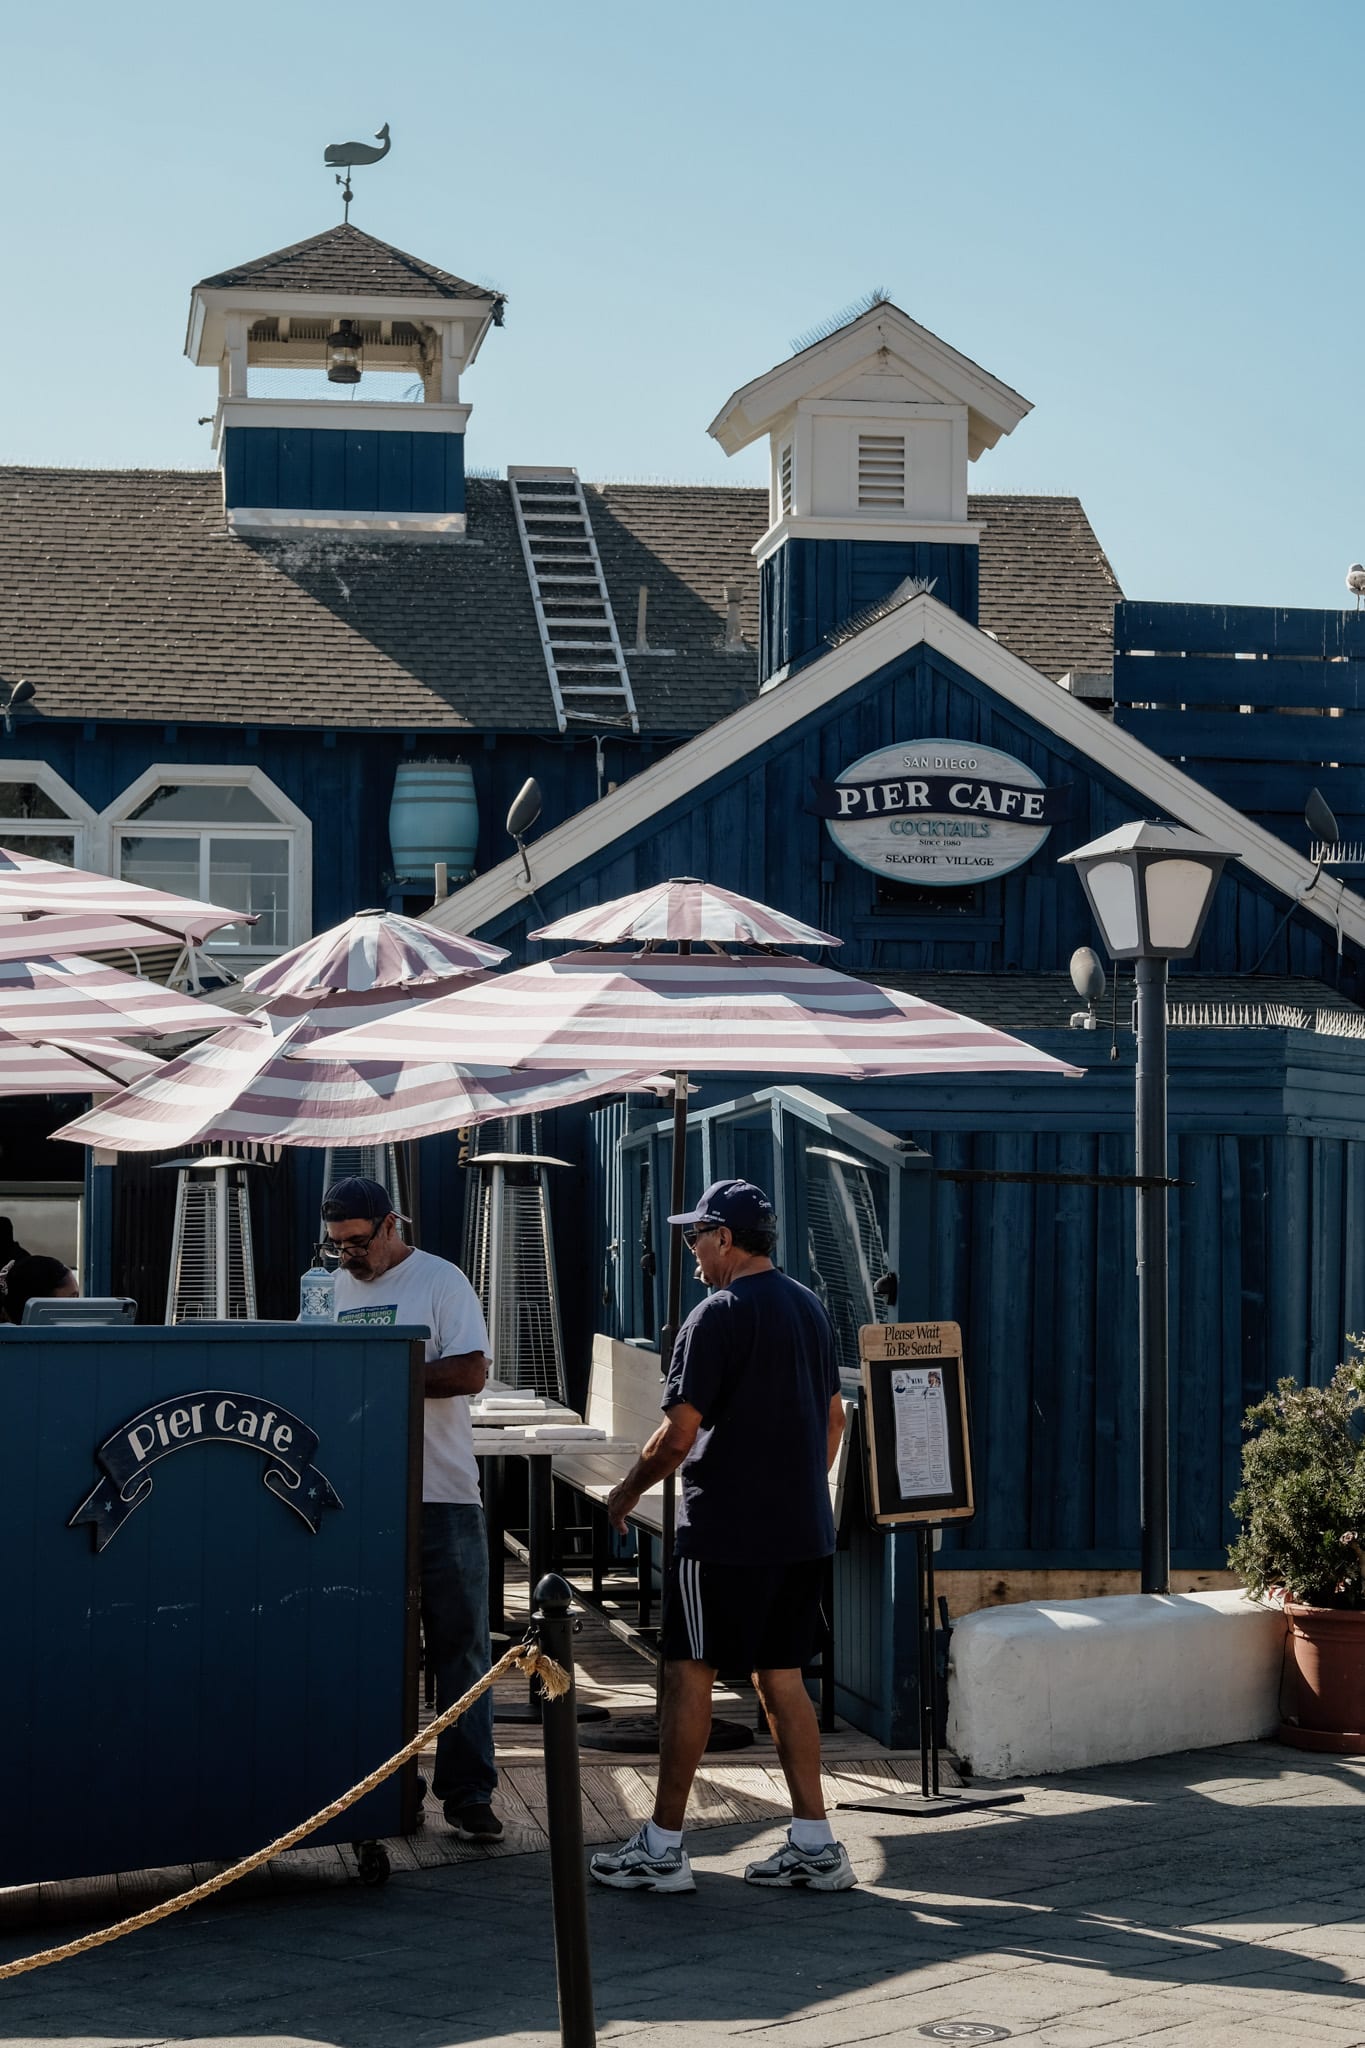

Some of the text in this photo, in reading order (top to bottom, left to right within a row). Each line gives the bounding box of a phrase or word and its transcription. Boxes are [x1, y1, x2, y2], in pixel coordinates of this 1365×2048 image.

[903, 756, 978, 769] SAN DIEGO
[836, 781, 1045, 819] PIER CAFE
[889, 819, 991, 838] COCKTAILS
[885, 854, 994, 866] SEAPORT VILLAGE
[884, 1324, 940, 1341] Please Wait
[884, 1339, 942, 1357] To Be Seated
[127, 1400, 293, 1462] Pier Cafe
